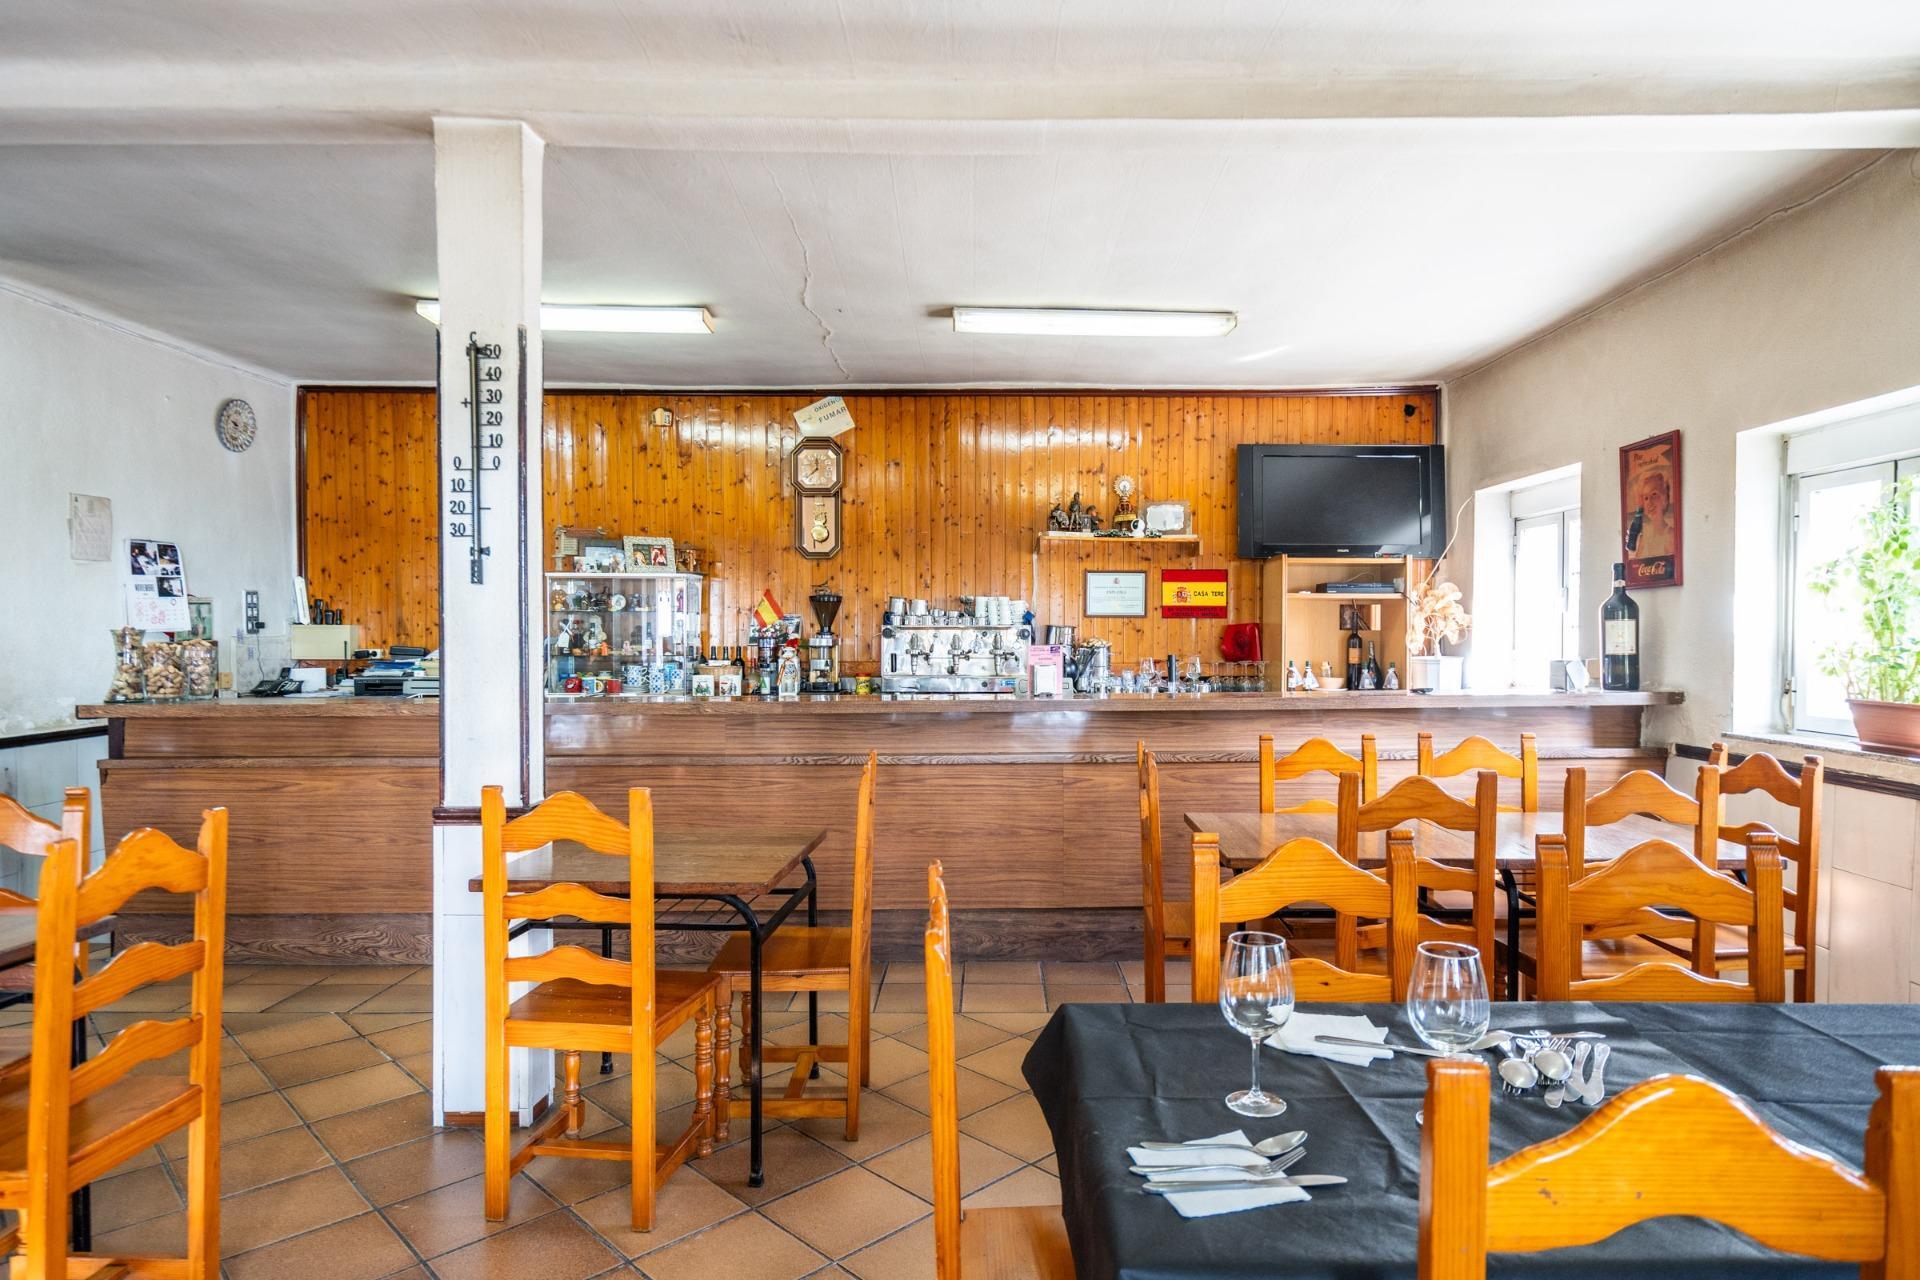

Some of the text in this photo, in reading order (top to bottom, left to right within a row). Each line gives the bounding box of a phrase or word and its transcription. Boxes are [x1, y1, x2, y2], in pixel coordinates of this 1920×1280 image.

[485, 344, 501, 358] 50
[486, 366, 502, 380] 40
[486, 389, 502, 402] 30
[486, 411, 503, 425] 20
[818, 407, 846, 423] FUMAR
[489, 433, 503, 447] 10
[453, 456, 501, 469] 0 0
[451, 478, 465, 492] 10
[449, 500, 466, 514] 20
[449, 522, 466, 536] 30
